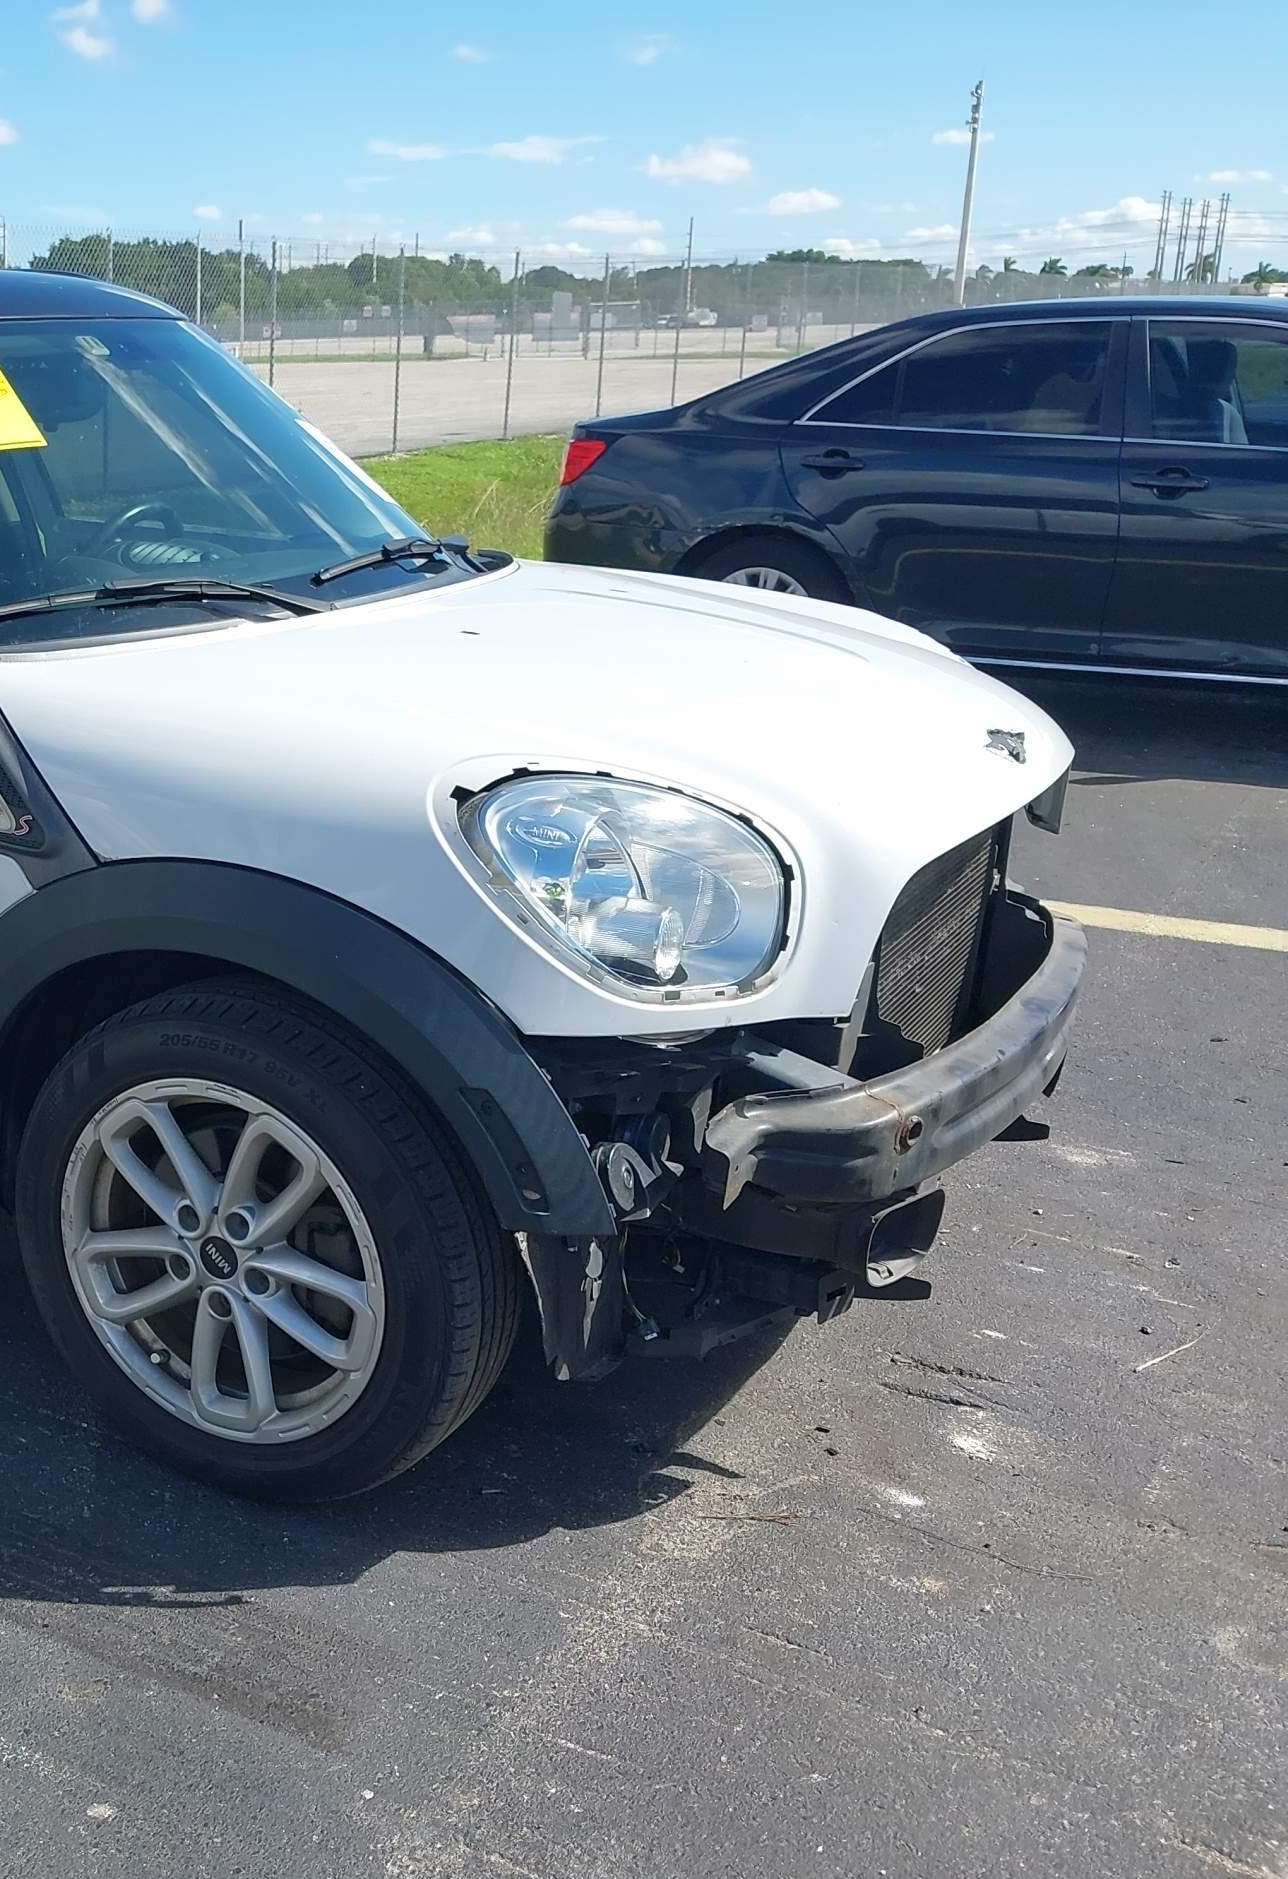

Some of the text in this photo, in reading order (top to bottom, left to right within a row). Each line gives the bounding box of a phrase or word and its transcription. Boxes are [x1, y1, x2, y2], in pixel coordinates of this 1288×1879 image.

[14, 814, 33, 836] S
[159, 1033, 221, 1051] 205/55
[223, 1043, 258, 1064] R17
[205, 1243, 232, 1274] MINI
